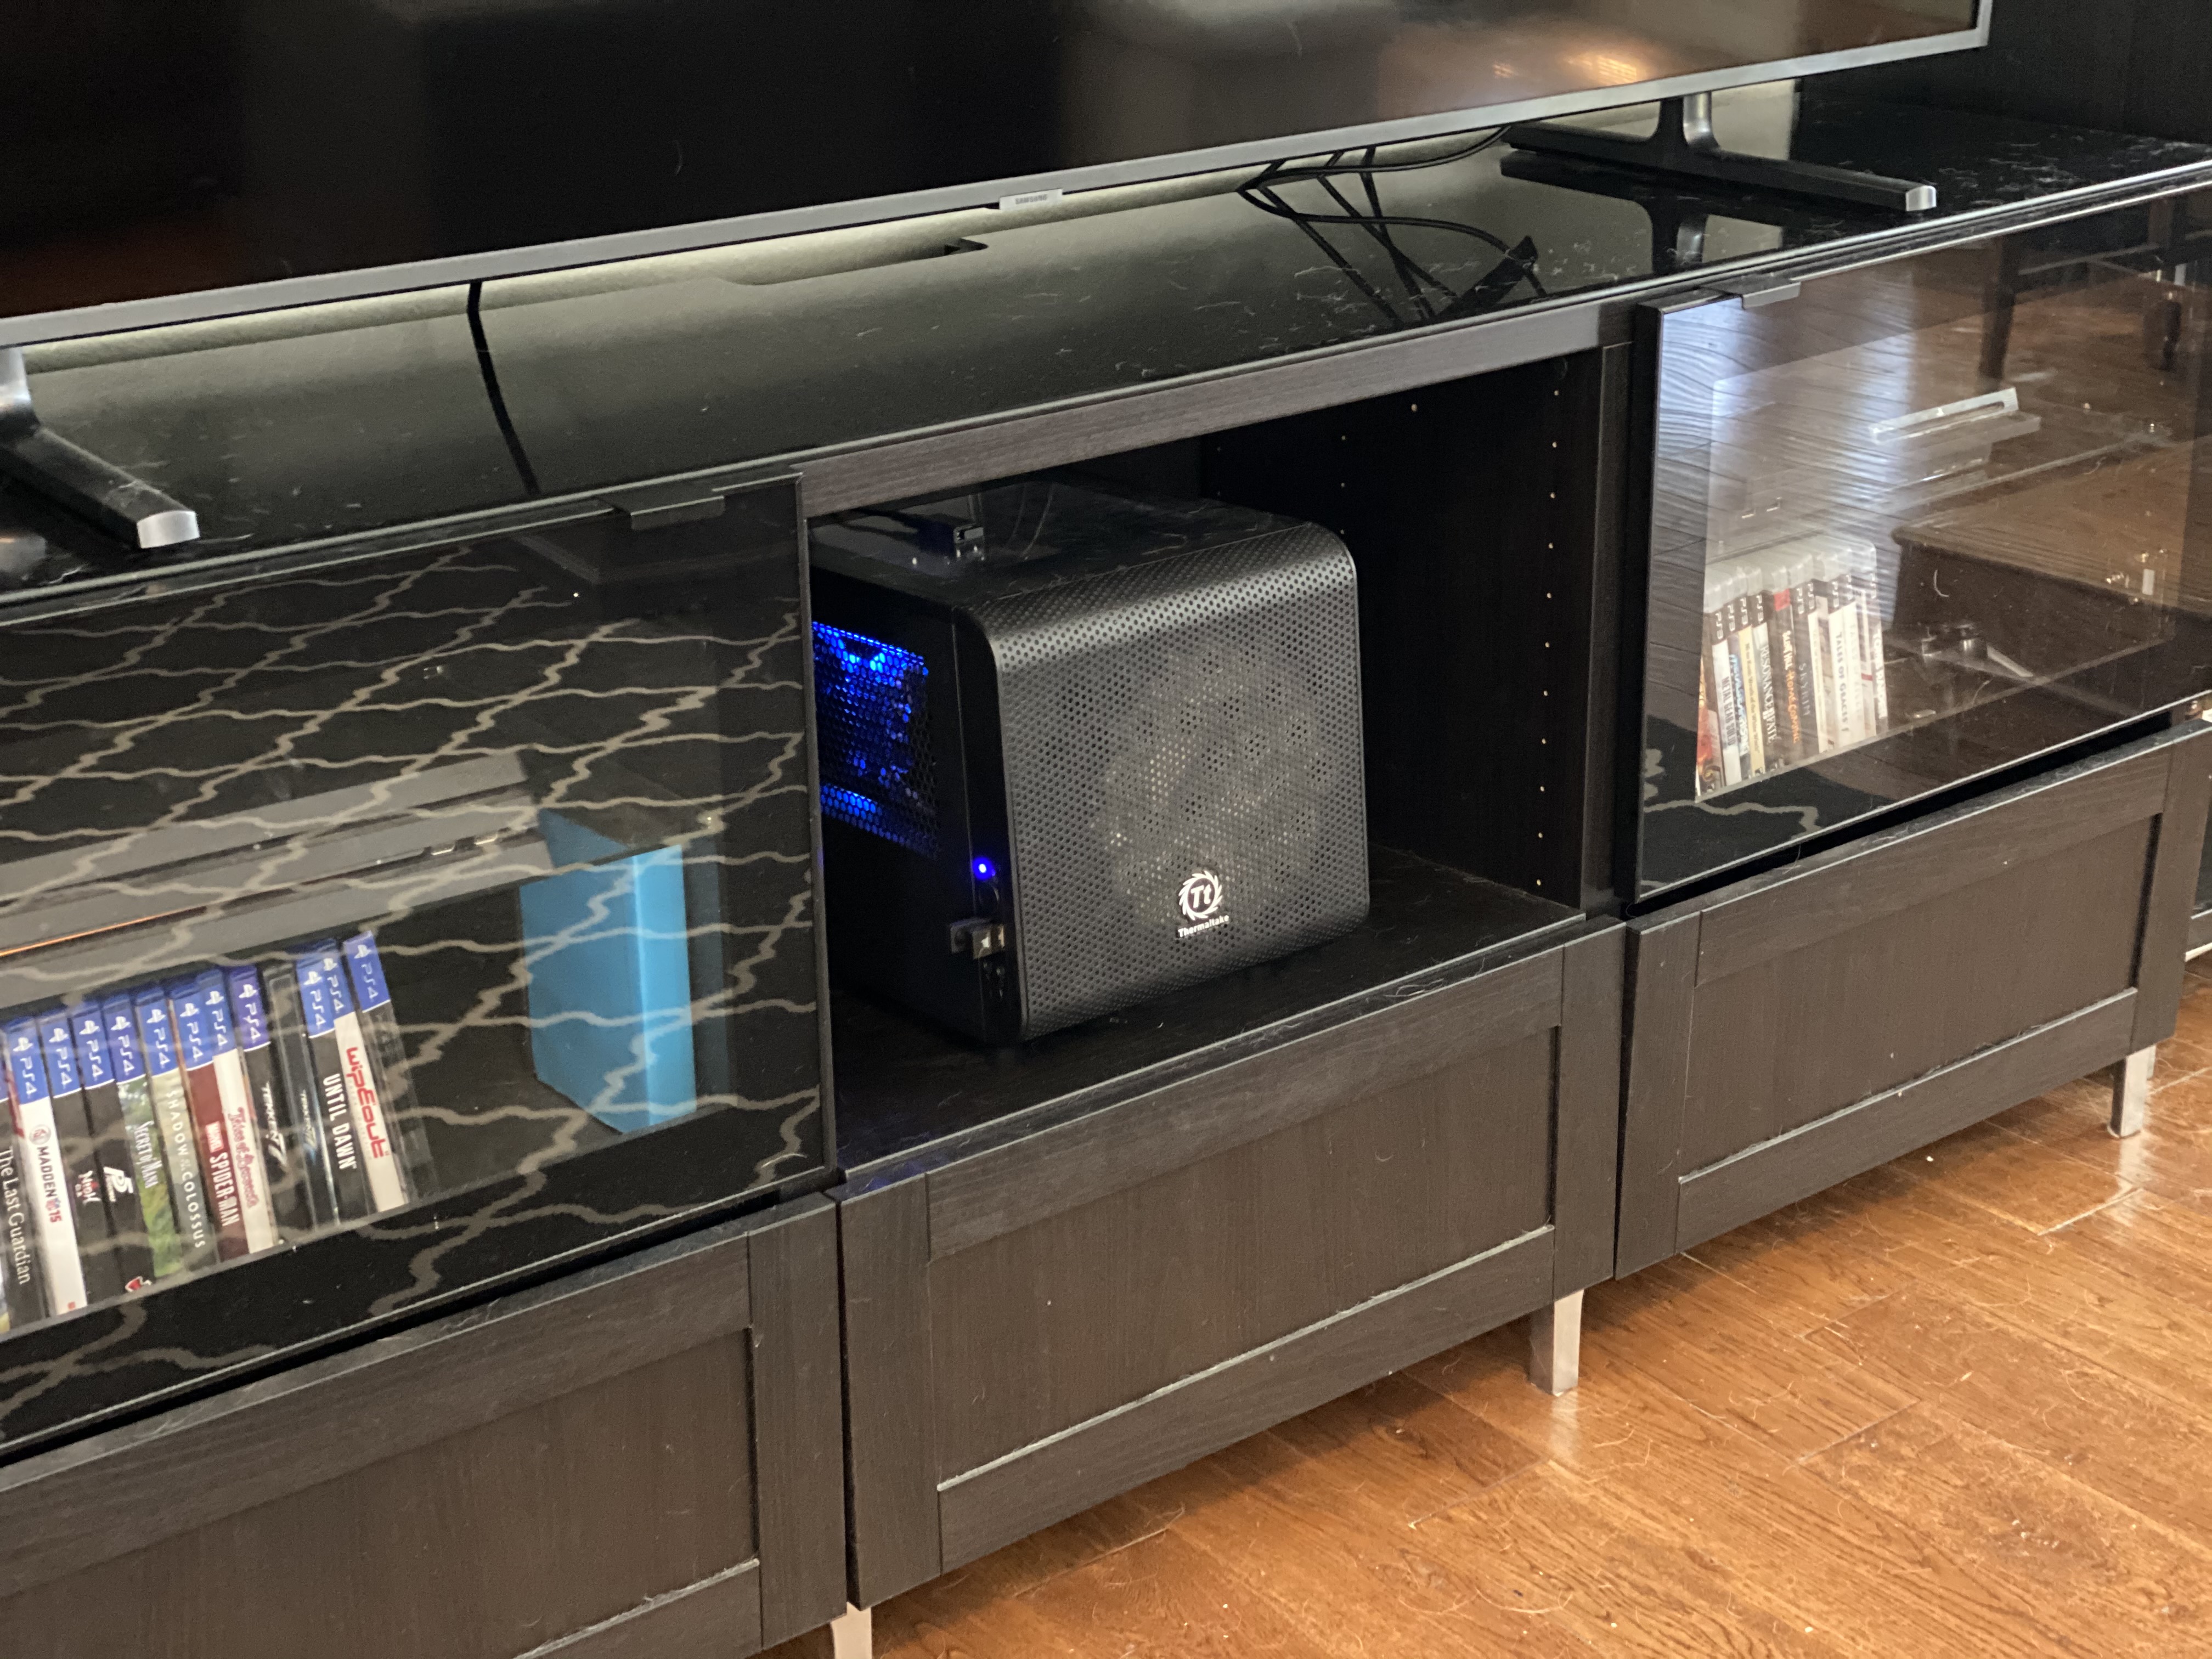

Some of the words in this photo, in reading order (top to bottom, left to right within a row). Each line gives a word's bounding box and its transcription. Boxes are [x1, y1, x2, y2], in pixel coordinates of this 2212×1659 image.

[1015, 194, 1047, 204] SAMSUNG
[1727, 603, 1735, 631] PS3
[1740, 597, 1748, 625] PS3
[1796, 588, 1804, 614] PS3
[1715, 612, 1723, 639] PS3
[1722, 676, 1732, 703] METAL
[1760, 645, 1774, 711] RESONANCE
[1799, 663, 1810, 716] SKYRIM
[1724, 702, 1735, 724] GEAR
[1839, 683, 1848, 723] GRACES
[1726, 723, 1737, 746] SOLID
[1765, 718, 1777, 744] FATE
[1178, 915, 1229, 938] Thermaltake
[327, 975, 345, 1014] PS4
[361, 963, 379, 1003] PS4
[212, 1008, 228, 1050] PS4
[245, 1002, 261, 1044] PS4
[310, 989, 326, 1030] PS4
[86, 1039, 104, 1081] PS4
[118, 1035, 135, 1075] PS4
[154, 1027, 171, 1069] PS4
[187, 1022, 204, 1063] PS4
[20, 1056, 37, 1098] PS4
[56, 1047, 72, 1090] PS4
[261, 1081, 279, 1145] TEKKEN
[300, 1089, 313, 1135] TEKKEN
[323, 1073, 347, 1122] UNTIL
[0, 1145, 14, 1177] The
[332, 1122, 356, 1170] DAWN
[37, 1146, 57, 1198] MADDEN
[49, 1213, 63, 1223] 15
[140, 1160, 162, 1189] MANA
[166, 1090, 189, 1156] SHADOW
[182, 1171, 206, 1248] COLOSSUS
[210, 1152, 240, 1227] SPIDER-MAN
[3, 1177, 21, 1211] Last
[8, 1212, 31, 1285] Guardian
